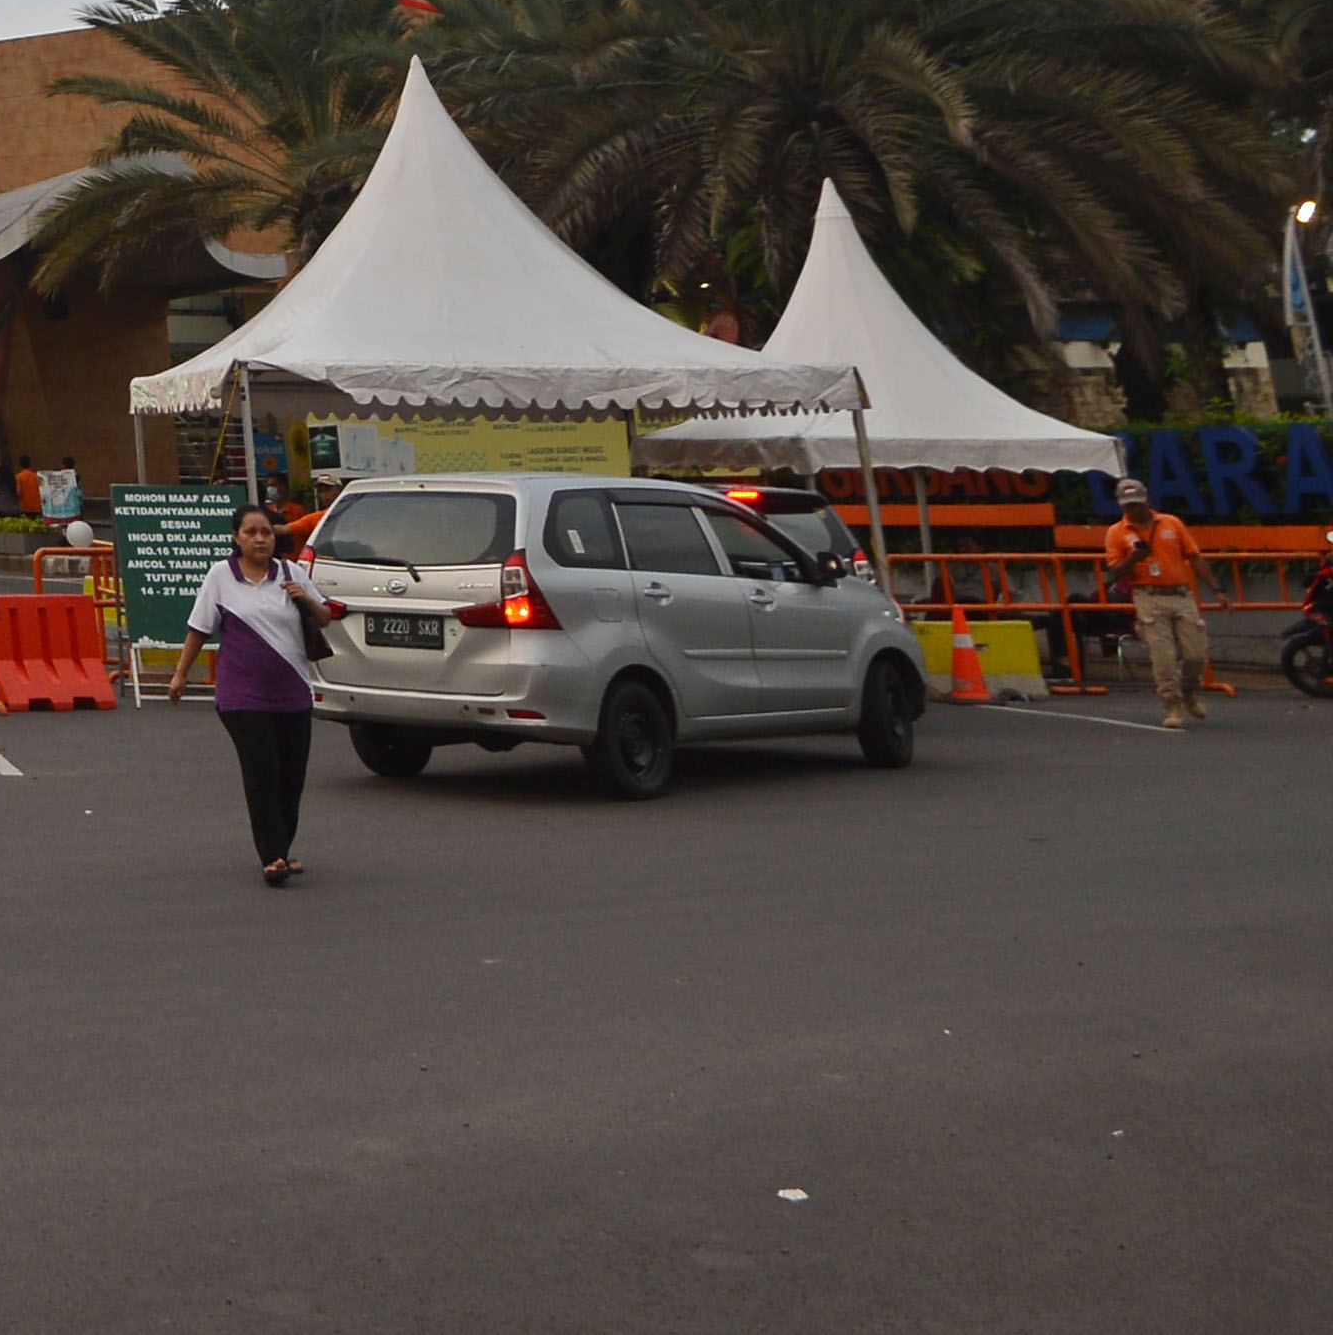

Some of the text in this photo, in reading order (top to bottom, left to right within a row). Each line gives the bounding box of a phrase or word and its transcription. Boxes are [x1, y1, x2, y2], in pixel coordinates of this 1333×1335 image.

[255, 444, 284, 455] oket
[125, 494, 231, 503] MOHON MAAF ATAS
[114, 507, 237, 516] KETIDAKNYAMANANN
[160, 520, 201, 529] SESUAI
[128, 533, 233, 543] INGUB DKI JAKART
[137, 547, 234, 556] NO.16 TAHUN 202
[128, 560, 165, 568] ANCOL
[168, 560, 207, 569] TAMAN
[145, 573, 206, 583] TUTUP PAD
[141, 587, 154, 596] 14
[163, 587, 176, 596] 27
[367, 617, 439, 636] B 2220 SKR
